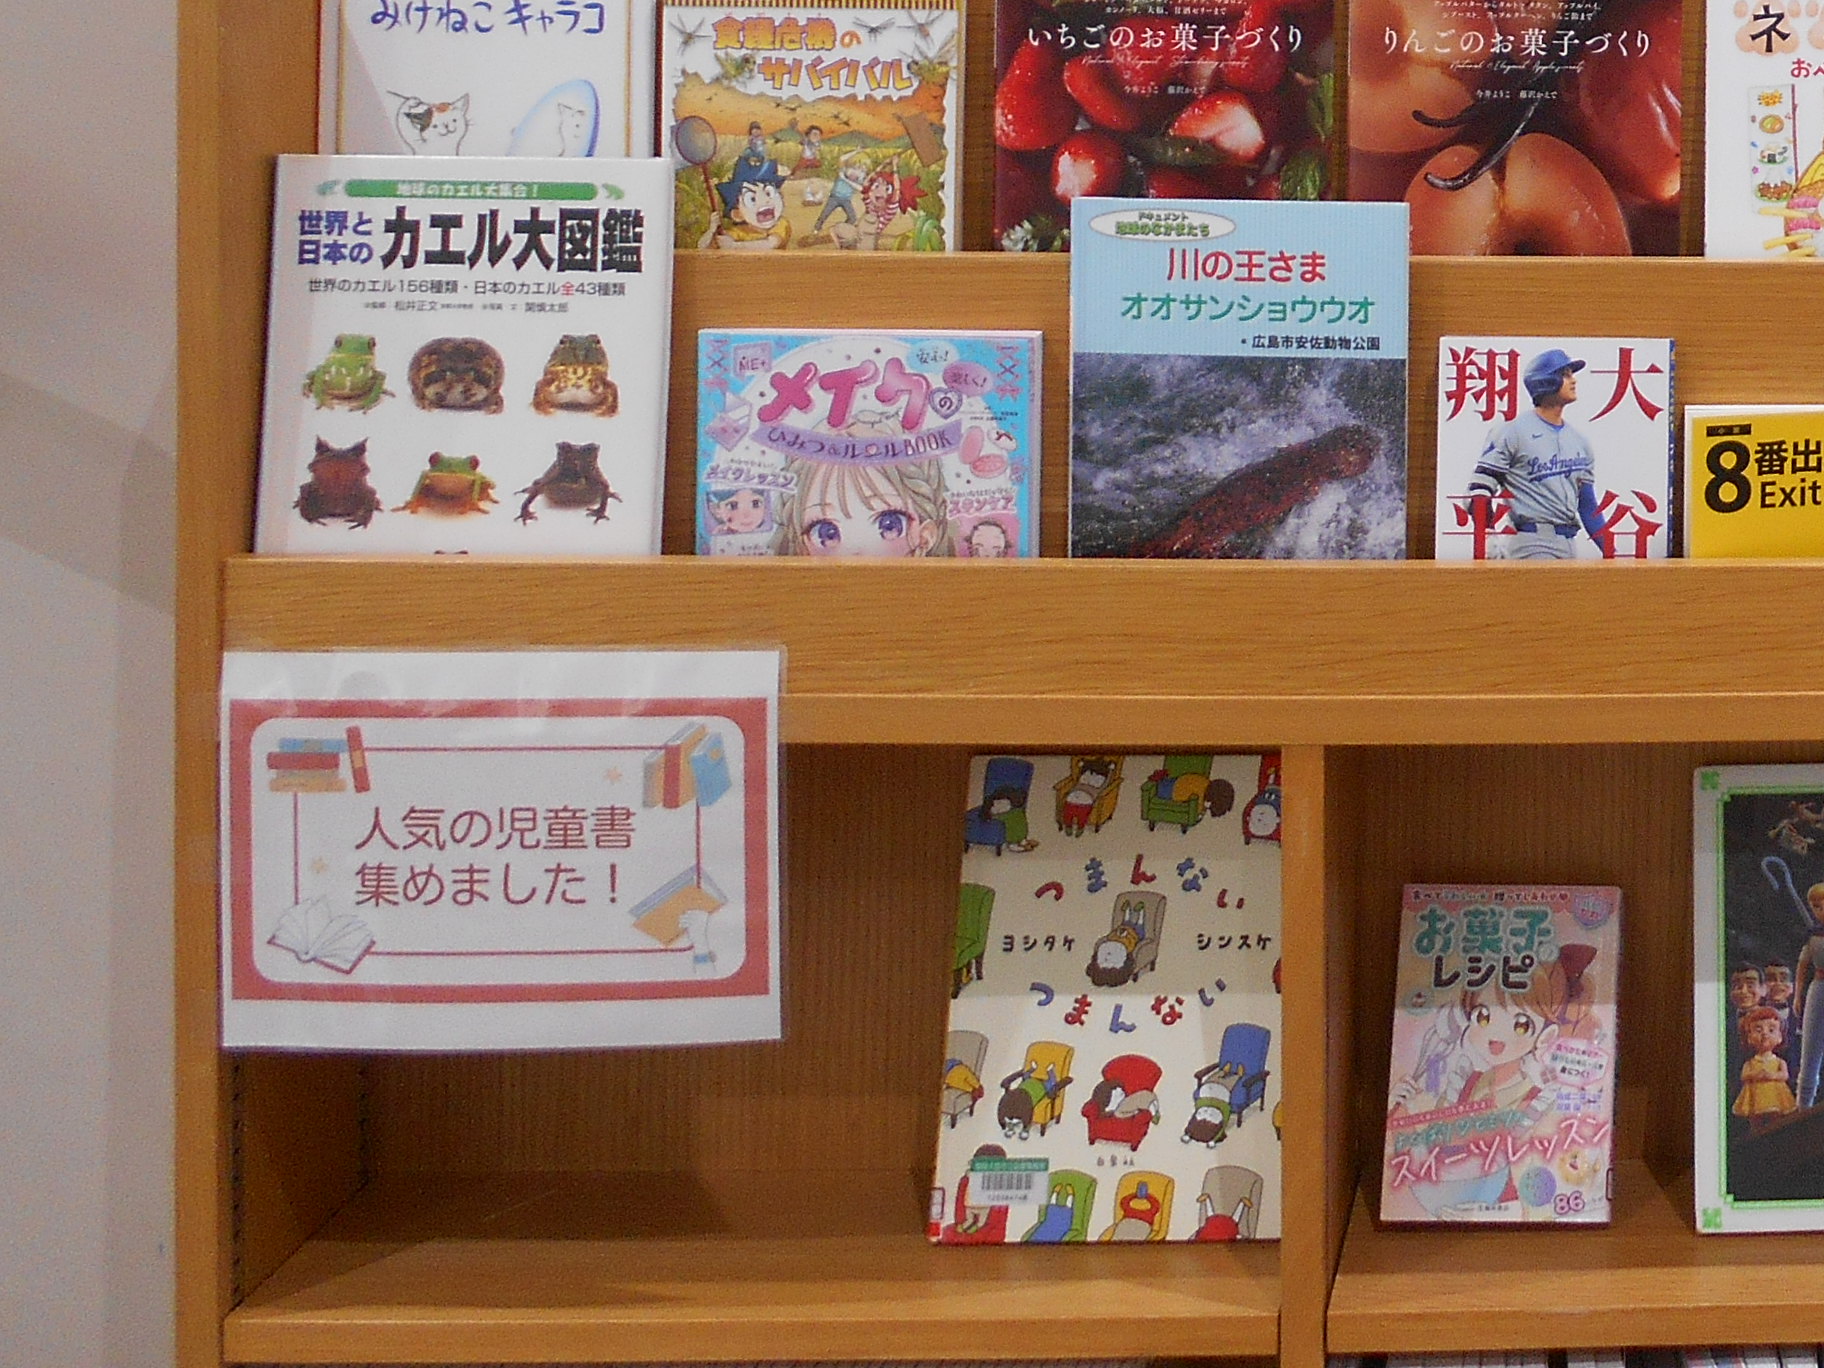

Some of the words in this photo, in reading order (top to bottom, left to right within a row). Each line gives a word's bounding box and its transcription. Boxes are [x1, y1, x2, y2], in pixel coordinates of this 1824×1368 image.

[712, 16, 862, 51] 食糧危機の
[1028, 23, 1302, 53] いちごのお菓子づくり
[1384, 26, 1650, 57] りんごのお菓子づくり
[757, 55, 915, 91] サバイバル
[298, 209, 373, 238] 世界と
[380, 205, 644, 274] カエル大図鑑
[298, 239, 373, 266] 日本の
[1167, 248, 1327, 282] 川の王さま
[308, 278, 626, 297] 世界のカエル156種類・日本のカエル全43種類
[1121, 293, 1375, 324] オオサンショウウオ
[1252, 335, 1380, 351] 広島市安佐動物公園
[757, 357, 932, 431] メイク
[1704, 439, 1752, 514] 8
[1759, 480, 1821, 509] Exit
[355, 805, 635, 850] 人気の児童書
[355, 863, 619, 907] 集めました！
[1035, 853, 1244, 910] つまんない
[1002, 934, 1075, 952] ヨシタケ
[1197, 932, 1272, 952] シンスケ
[1432, 952, 1536, 990] レシピ
[1029, 978, 1227, 1033] つまんない
[1391, 1120, 1610, 1186] スイーツレッスン
[1553, 1191, 1586, 1215] 86
